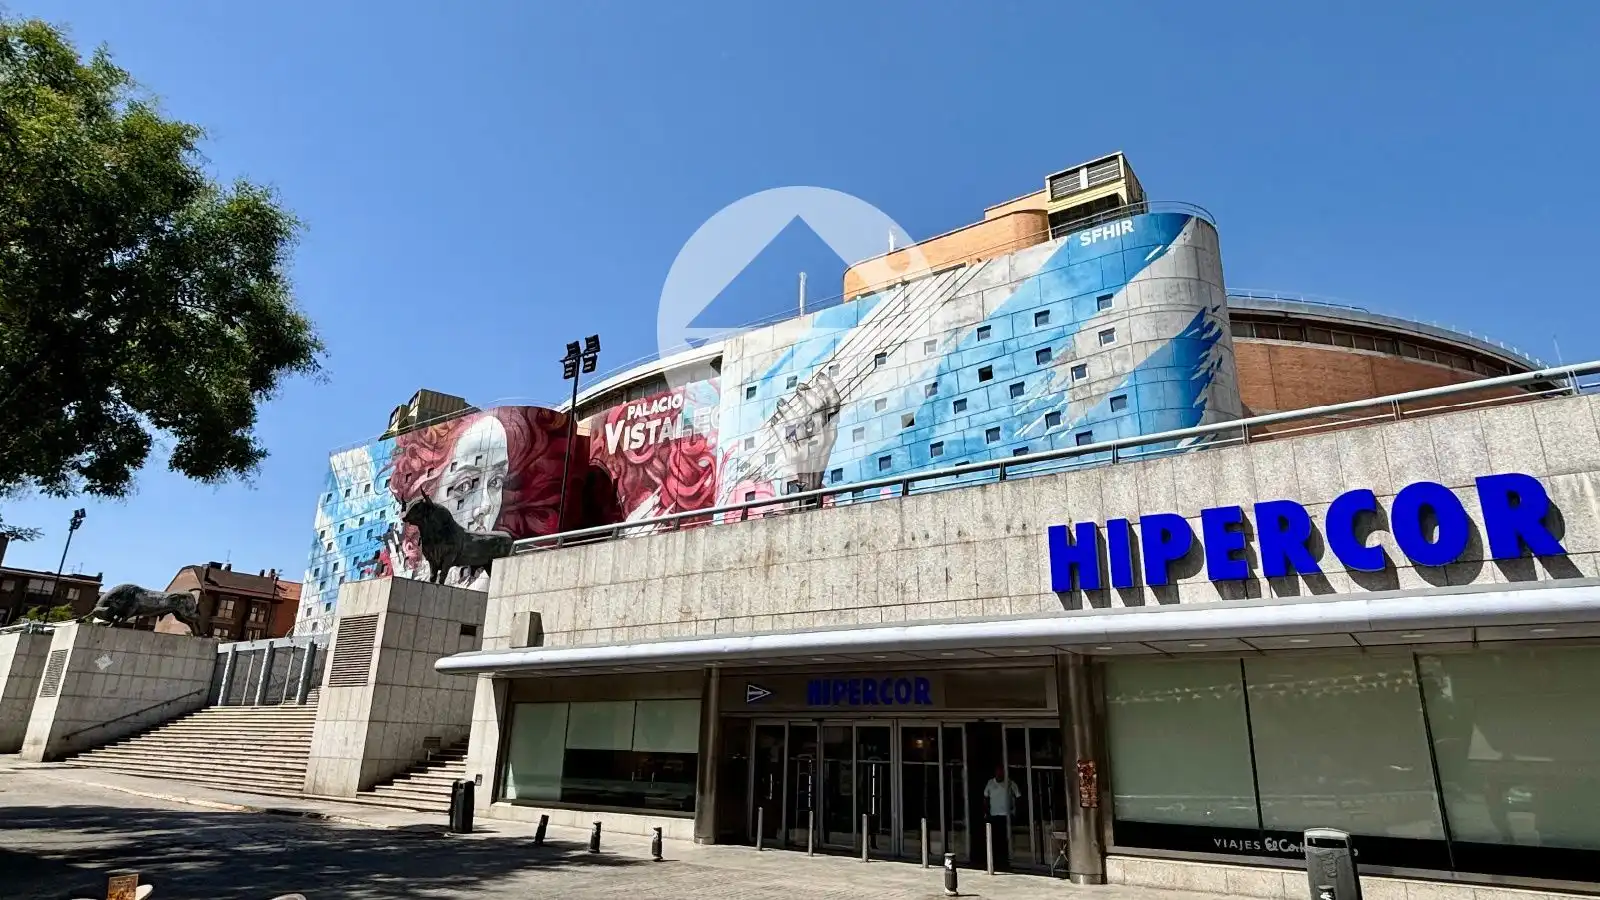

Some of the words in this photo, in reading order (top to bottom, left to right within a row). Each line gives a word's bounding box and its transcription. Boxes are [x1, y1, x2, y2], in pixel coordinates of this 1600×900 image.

[1080, 219, 1135, 247] SFHIR
[627, 393, 684, 420] PALACIO
[1048, 472, 1568, 593] HIPERCOR
[807, 676, 934, 706] HIPERCOR
[1213, 838, 1261, 851] VIAJES
[1279, 839, 1306, 853] Cort
